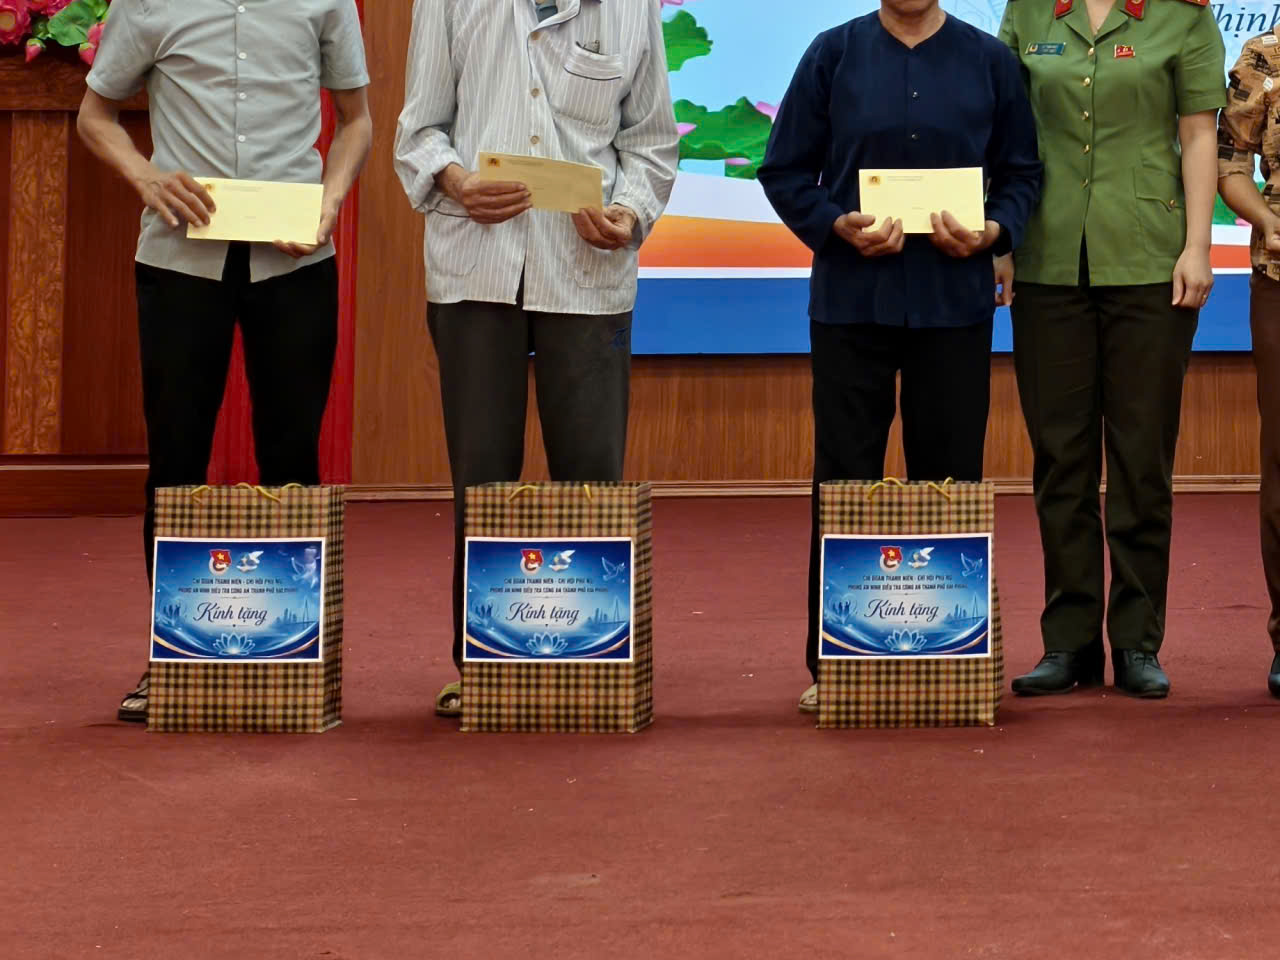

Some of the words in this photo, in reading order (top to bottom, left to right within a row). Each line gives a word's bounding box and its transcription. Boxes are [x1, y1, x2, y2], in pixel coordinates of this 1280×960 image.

[193, 602, 233, 621] Kính
[237, 605, 268, 625] tặng
[506, 601, 546, 621] Kính
[550, 604, 581, 625] tặng
[864, 598, 905, 619] Kính
[909, 601, 940, 622] tặng
